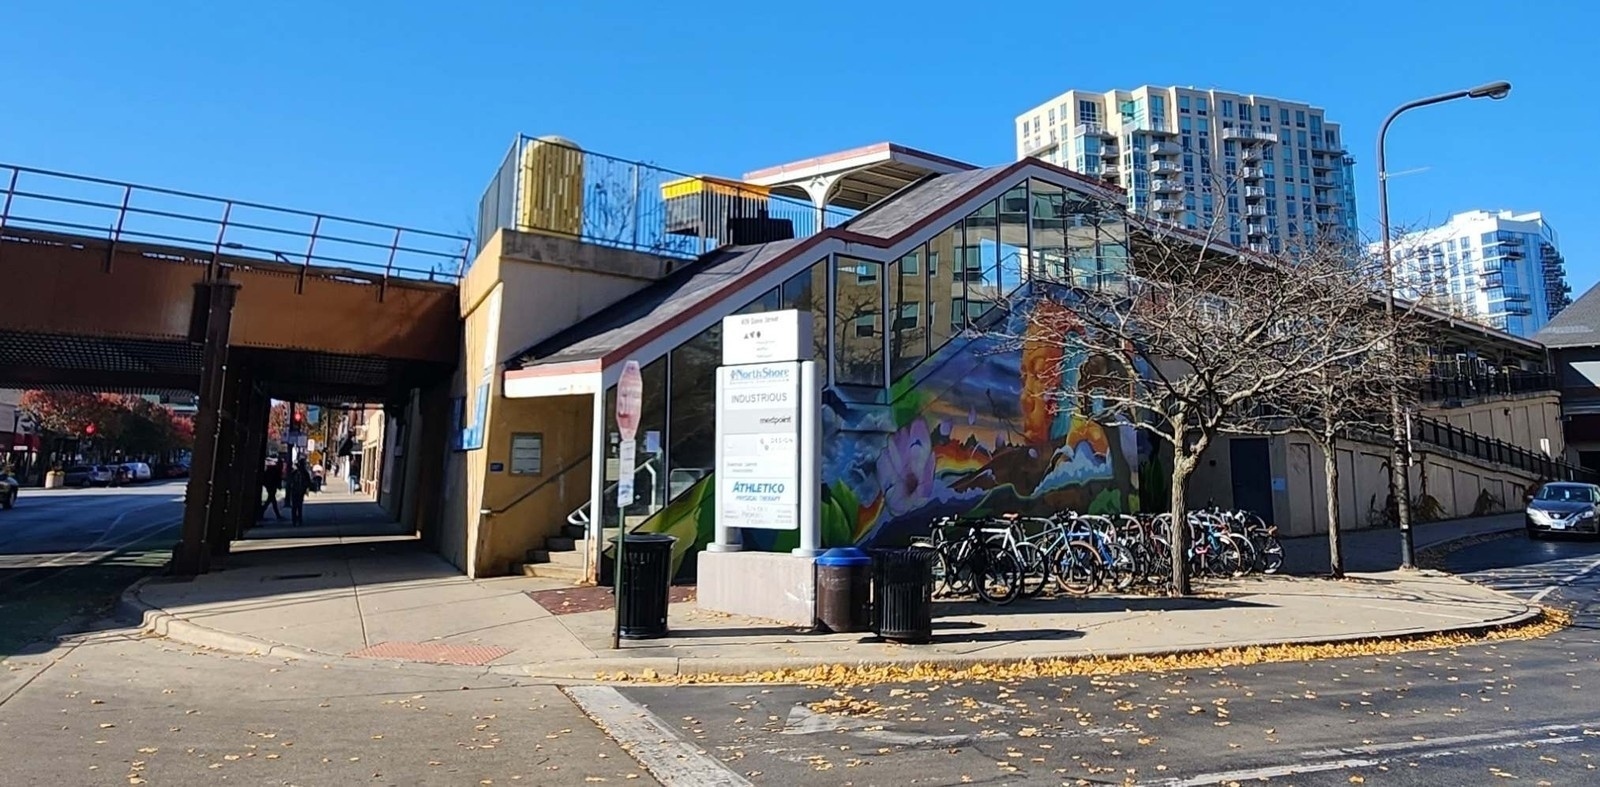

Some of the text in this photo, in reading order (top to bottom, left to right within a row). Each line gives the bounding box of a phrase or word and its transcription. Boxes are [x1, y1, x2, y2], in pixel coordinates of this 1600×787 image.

[736, 367, 789, 379] NorthShore
[731, 392, 788, 404] INDUSTRIOUS
[732, 481, 785, 494] ATHLETICO
